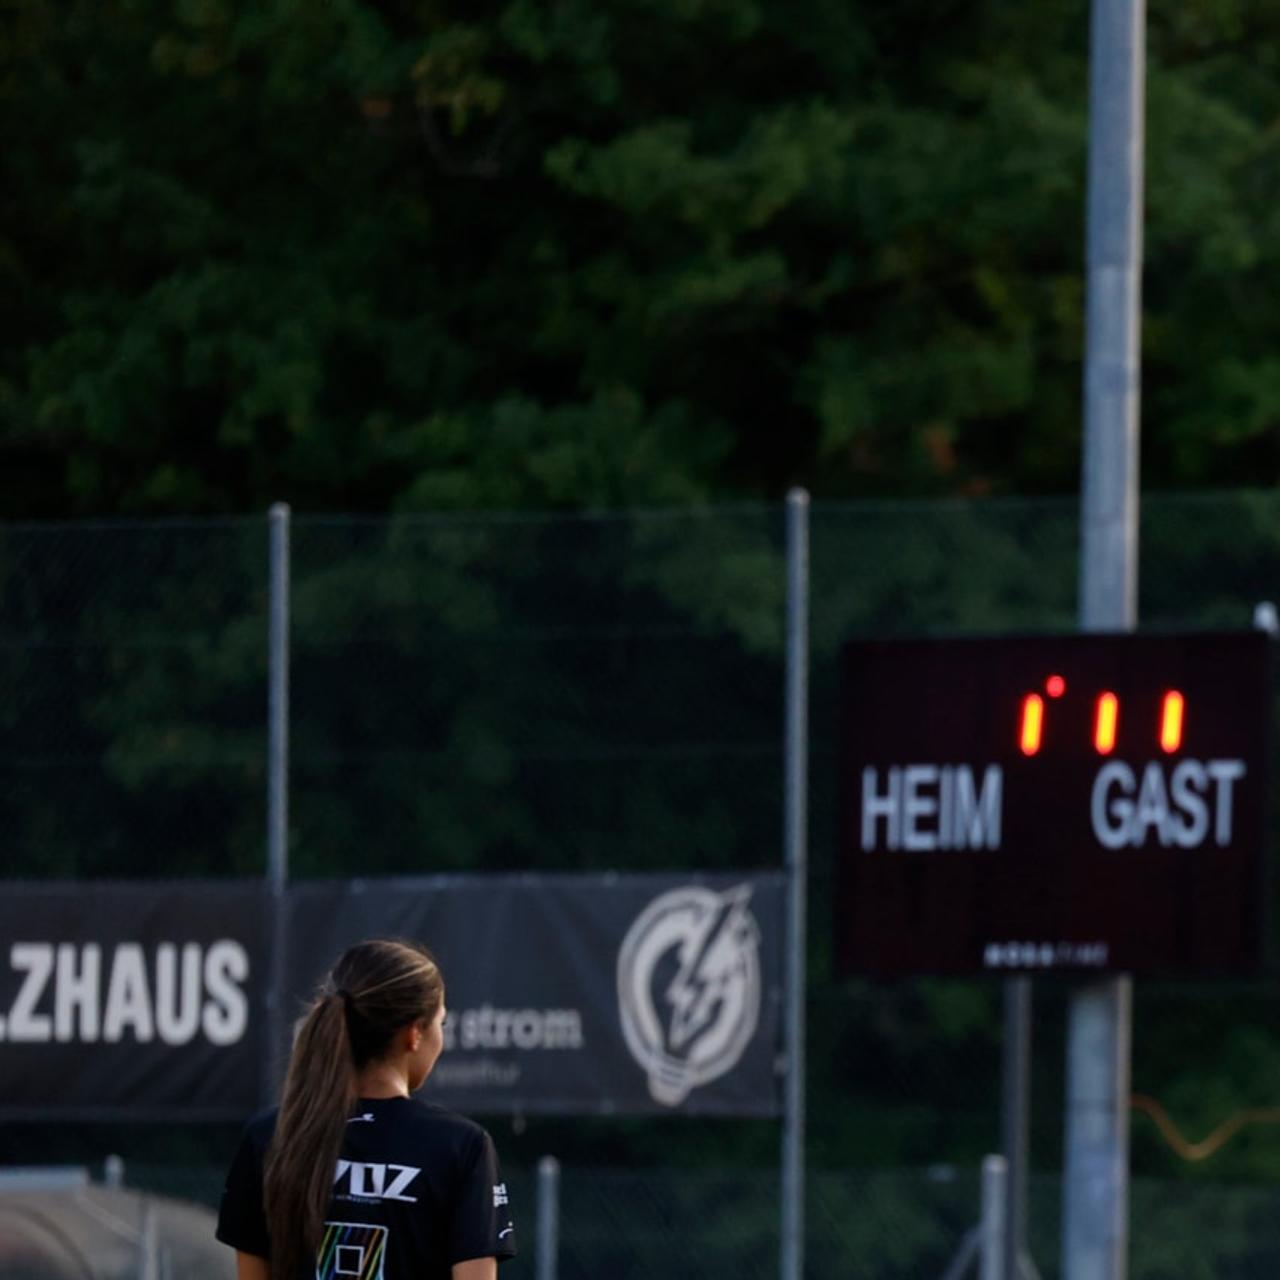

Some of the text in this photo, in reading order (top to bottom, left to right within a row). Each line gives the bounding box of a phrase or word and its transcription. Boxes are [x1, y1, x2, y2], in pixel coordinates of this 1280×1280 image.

[860, 759, 1246, 851] HEIM GAST
[0, 938, 250, 1046] ZHAUS
[459, 1003, 584, 1050] strom
